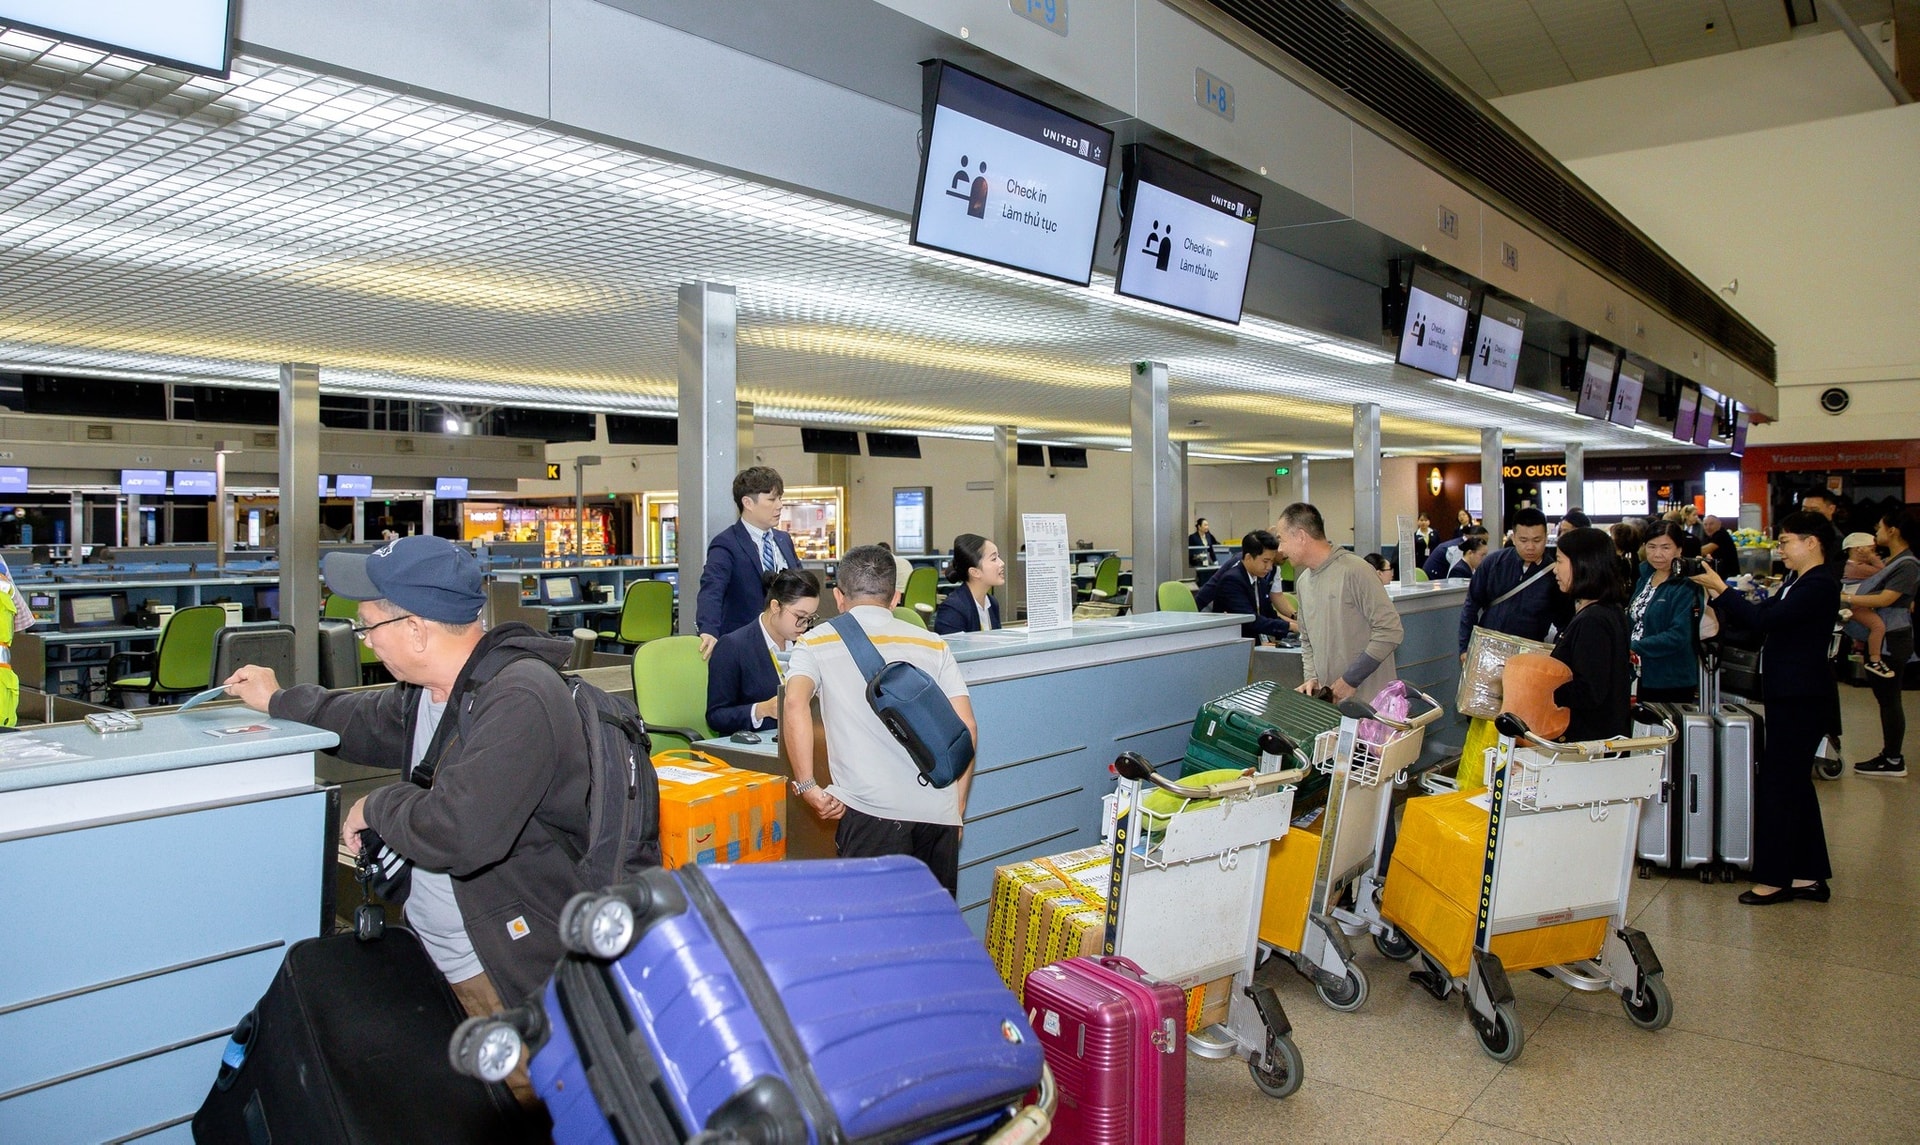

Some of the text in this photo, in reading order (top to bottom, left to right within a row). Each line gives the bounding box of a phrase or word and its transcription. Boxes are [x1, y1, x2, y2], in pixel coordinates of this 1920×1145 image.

[1206, 78, 1227, 113] I-8
[1043, 127, 1079, 149] UNITED
[1006, 178, 1047, 204] Check in
[1210, 194, 1236, 211] UNITED
[1002, 203, 1058, 234] Làm thủ tục
[1183, 237, 1213, 257] Check in
[1179, 258, 1219, 282] Làm thủ tục
[1772, 451, 1901, 464] Vietnamese Specialties
[548, 465, 559, 479] K
[1487, 778, 1504, 861] GOLDSUN
[1108, 828, 1127, 926] GOLDSUN
[1479, 874, 1492, 930] GROUP
